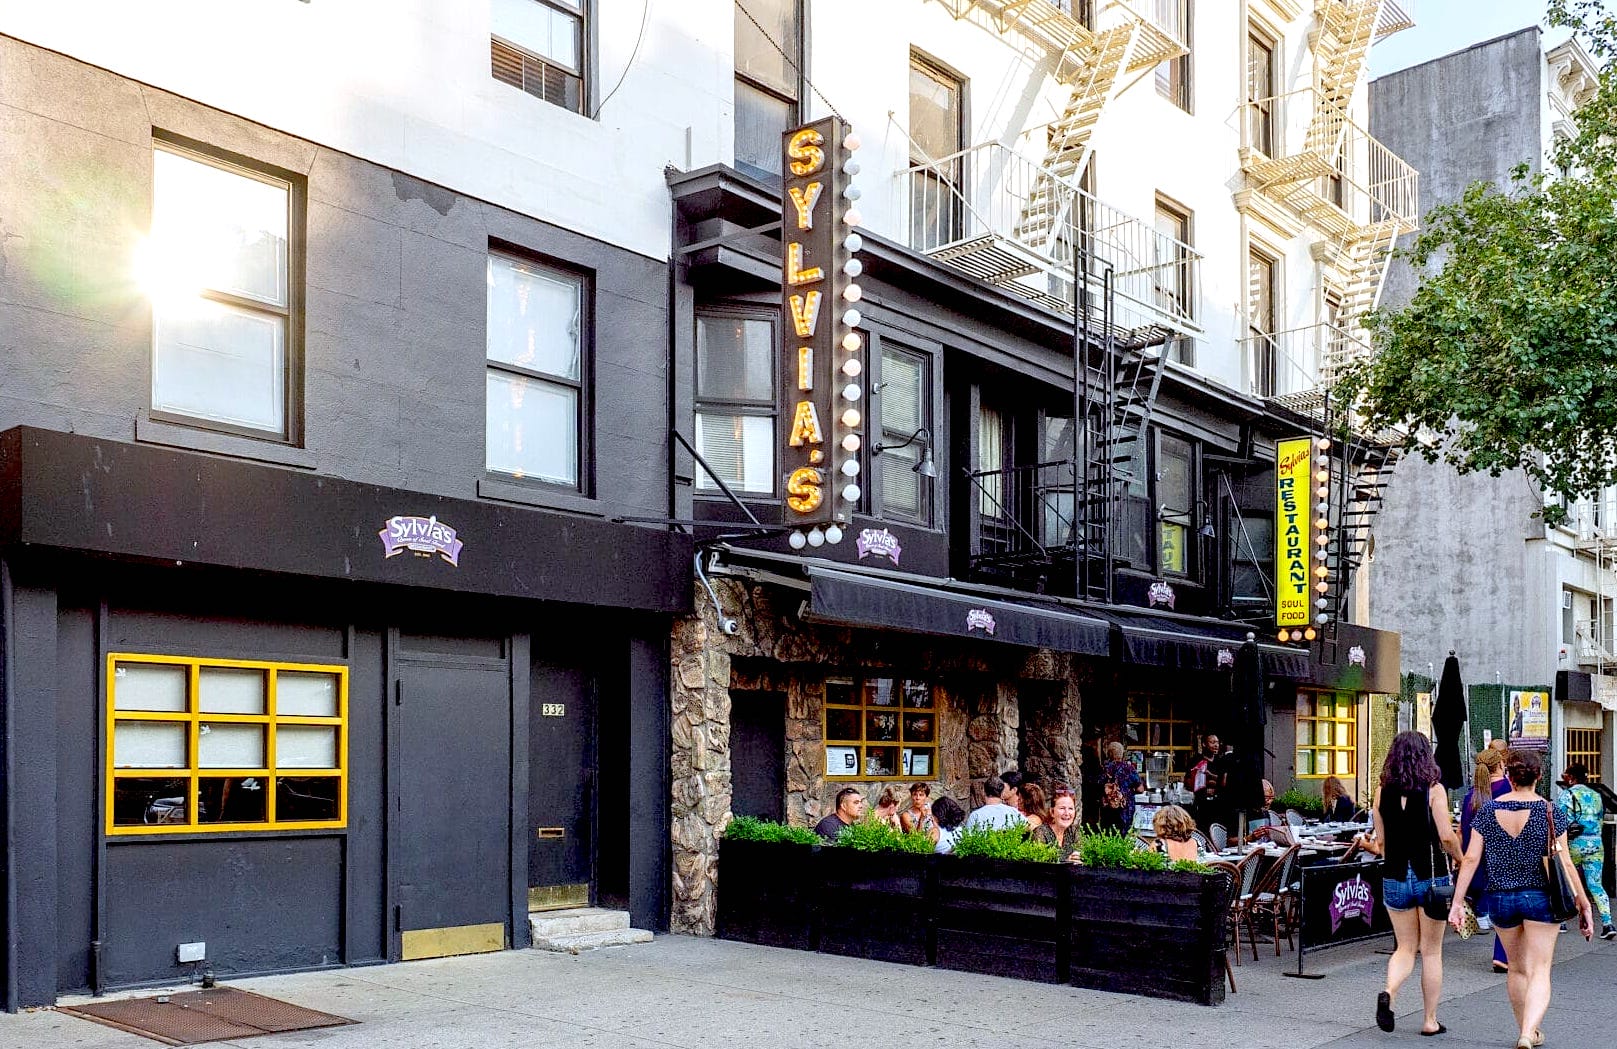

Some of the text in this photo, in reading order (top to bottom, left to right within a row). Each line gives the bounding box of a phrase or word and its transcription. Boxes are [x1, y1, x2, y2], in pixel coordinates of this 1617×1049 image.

[787, 129, 826, 513] SYLVIA'S
[390, 515, 452, 544] Sylvia's
[862, 528, 896, 549] Sylvia's
[1279, 477, 1307, 594] RESTAURANT
[1281, 600, 1304, 609] SOUL
[1281, 612, 1304, 620] FOOD
[544, 704, 564, 714] 332
[1335, 873, 1369, 909] Sylvia's
